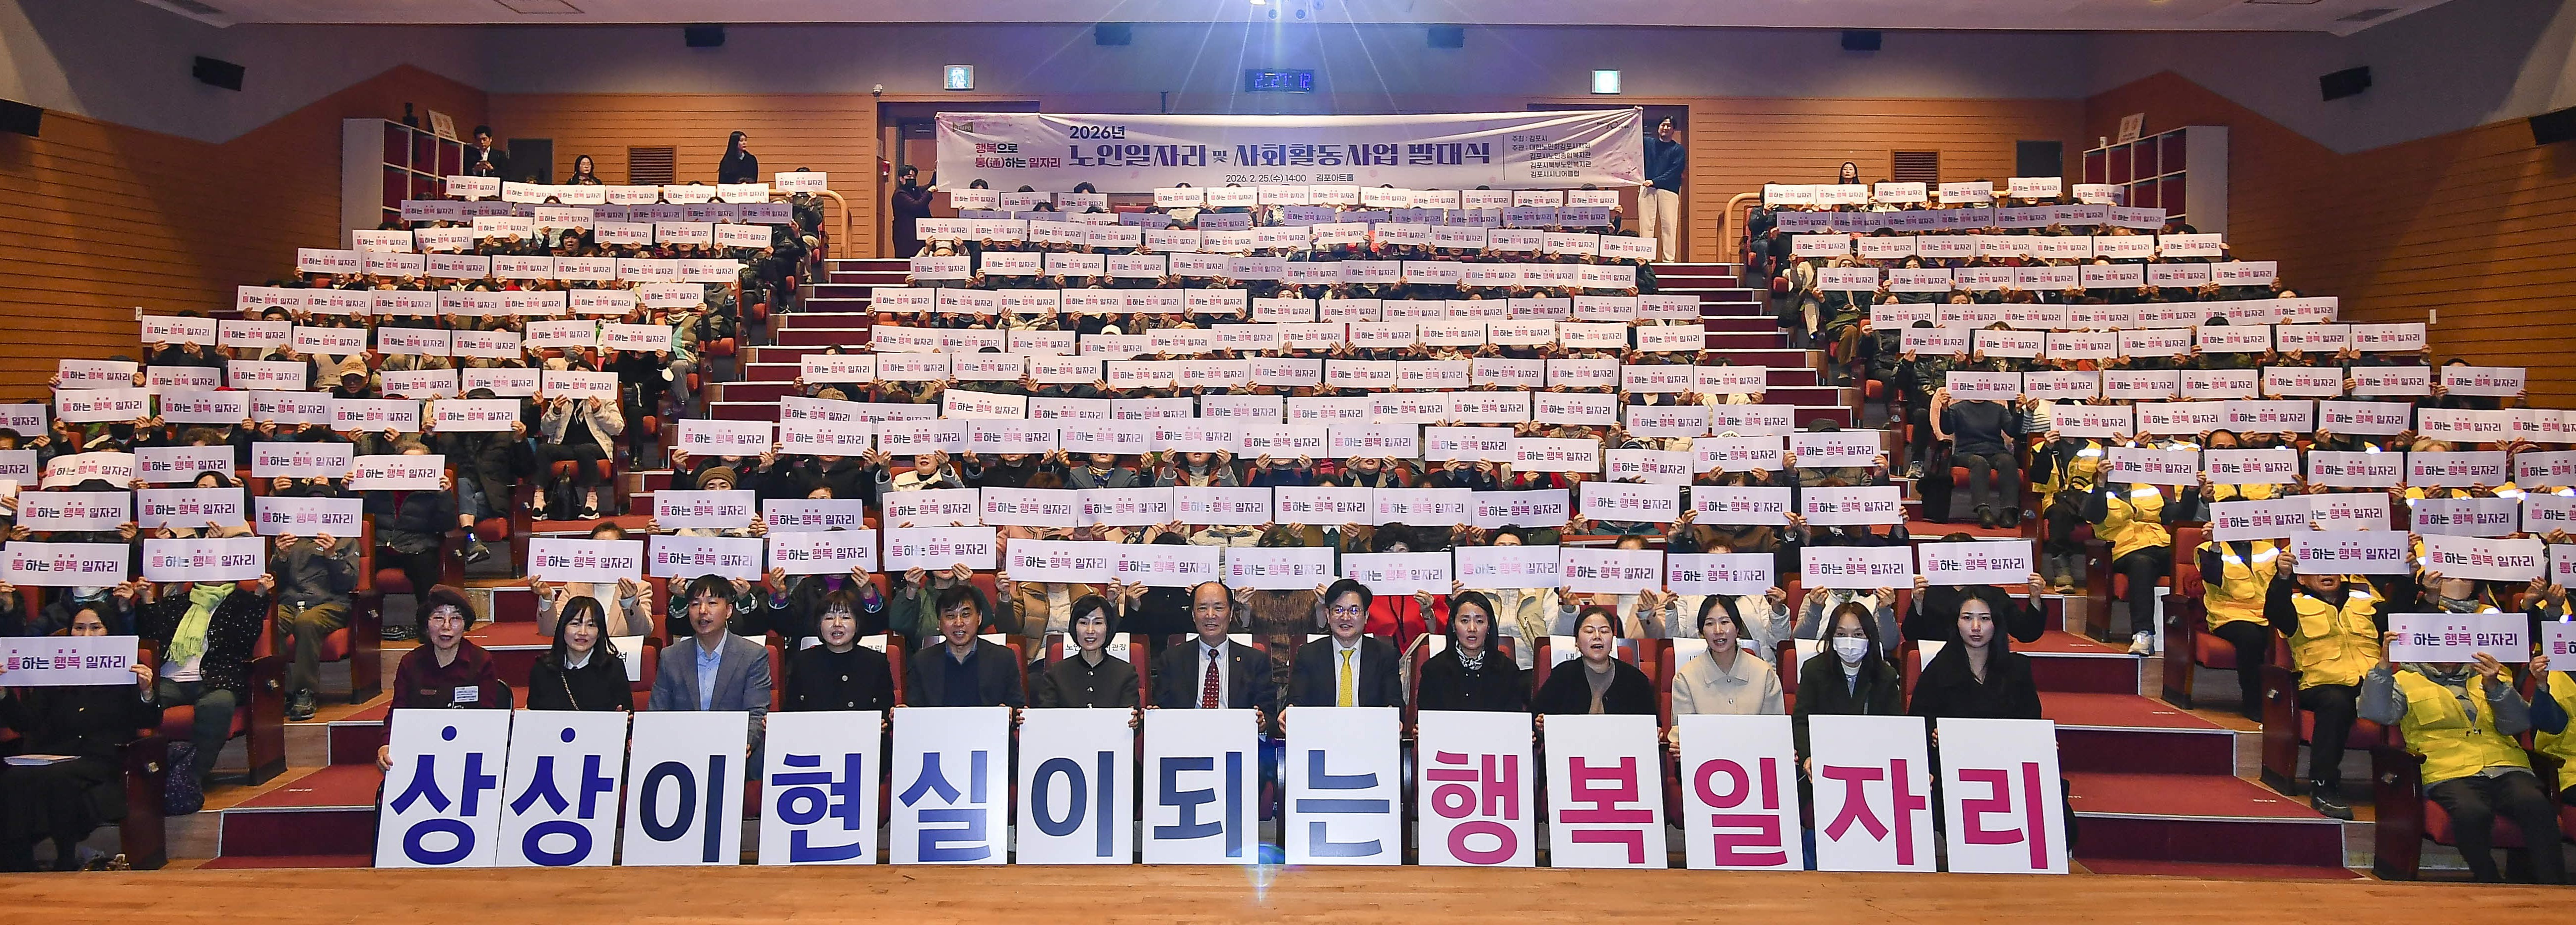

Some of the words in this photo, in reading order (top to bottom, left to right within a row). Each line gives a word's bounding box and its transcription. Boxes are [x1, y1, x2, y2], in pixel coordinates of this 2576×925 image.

[1069, 126, 1125, 140] 2026년
[975, 143, 1018, 154] 행복으로
[1069, 144, 1206, 167] 노인일자리
[1212, 150, 1228, 163] 및
[1234, 143, 1398, 166] 사회활동사업
[1408, 142, 1490, 166] 발대식
[975, 157, 1026, 168] 통(通)하는
[1029, 157, 1061, 168] 일자리
[1316, 173, 1353, 182] 김포아트홀
[63, 403, 91, 412] 통하는
[94, 402, 112, 411] 행복
[116, 401, 141, 410] 일자리
[1419, 405, 1442, 413] 일자리
[439, 412, 464, 421] 통하는
[468, 412, 484, 421] 행복
[488, 412, 513, 421] 일자리
[2056, 418, 2080, 427] 통하는
[2083, 418, 2098, 427] 행복
[2102, 419, 2126, 427] 일자리
[685, 434, 711, 443] 통하는
[717, 434, 733, 443] 행복
[738, 435, 764, 444] 일자리
[786, 433, 813, 443] 통하는
[817, 434, 834, 443] 행복
[838, 435, 863, 444] 일자리
[1244, 438, 1270, 447] 통하는
[1274, 438, 1291, 447] 행복
[1294, 438, 1320, 447] 일자리
[1518, 451, 1544, 460] 통하는
[1547, 452, 1563, 460] 행복
[1567, 452, 1591, 461] 일자리
[1796, 446, 1823, 456] 통하는
[1827, 446, 1844, 455] 행복
[1848, 446, 1873, 455] 일자리
[142, 461, 171, 471] 통하는
[175, 461, 194, 470] 행복
[198, 460, 226, 470] 일자리
[2315, 465, 2344, 475] 통하는
[2347, 466, 2365, 475] 행복
[2369, 466, 2396, 475] 일자리
[356, 469, 384, 478] 통하는
[388, 469, 405, 478] 행복
[409, 469, 436, 478] 일자리
[26, 507, 60, 518] 통하는
[64, 508, 85, 517] 행복
[89, 507, 121, 518] 일자리
[145, 504, 176, 515] 통하는
[179, 504, 199, 514] 행복
[203, 504, 235, 514] 일자리
[661, 506, 691, 516] 통하는
[694, 506, 713, 515] 행복
[718, 505, 746, 515] 일자리
[889, 505, 916, 517] 통하는
[920, 504, 938, 514] 행복
[943, 503, 971, 514] 일자리
[1282, 502, 1311, 511] 통하는
[1315, 502, 1333, 512] 행복
[1337, 502, 1365, 512] 일자리
[1478, 506, 1508, 516] 통하는
[1511, 506, 1529, 515] 행복
[1533, 504, 1561, 514] 일자리
[2219, 517, 2249, 528] 통하는
[2252, 515, 2271, 526] 행복
[2275, 514, 2304, 525] 일자리
[2419, 514, 2449, 524] 통하는
[2453, 514, 2473, 524] 행복
[2477, 513, 2509, 524] 일자리
[777, 549, 809, 560] 통하는
[813, 549, 832, 559] 행복
[837, 547, 867, 559] 일자리
[2299, 548, 2335, 560] 통하는
[2339, 548, 2361, 560] 행복
[2366, 549, 2400, 560] 일자리
[536, 556, 570, 567] 통하는
[574, 557, 595, 568] 행복
[600, 558, 632, 569] 일자리
[1928, 560, 1962, 570] 통하는
[1965, 559, 1987, 570] 행복
[1991, 558, 2024, 569] 일자리
[2433, 552, 2467, 565] 통하는
[2471, 554, 2493, 566] 행복
[2498, 556, 2534, 567] 일자리
[12, 560, 50, 571] 통하는
[54, 560, 77, 571] 행복
[82, 561, 118, 572] 일자리
[1809, 564, 1843, 574] 통하는
[1846, 564, 1866, 574] 행복
[1871, 564, 1904, 574] 일자리
[1566, 566, 1597, 578] 통하는
[1601, 567, 1620, 578] 행복
[1625, 568, 1653, 579] 일자리
[7, 657, 50, 670] 통하는
[54, 656, 81, 669] 행복
[86, 656, 126, 668] 일자리
